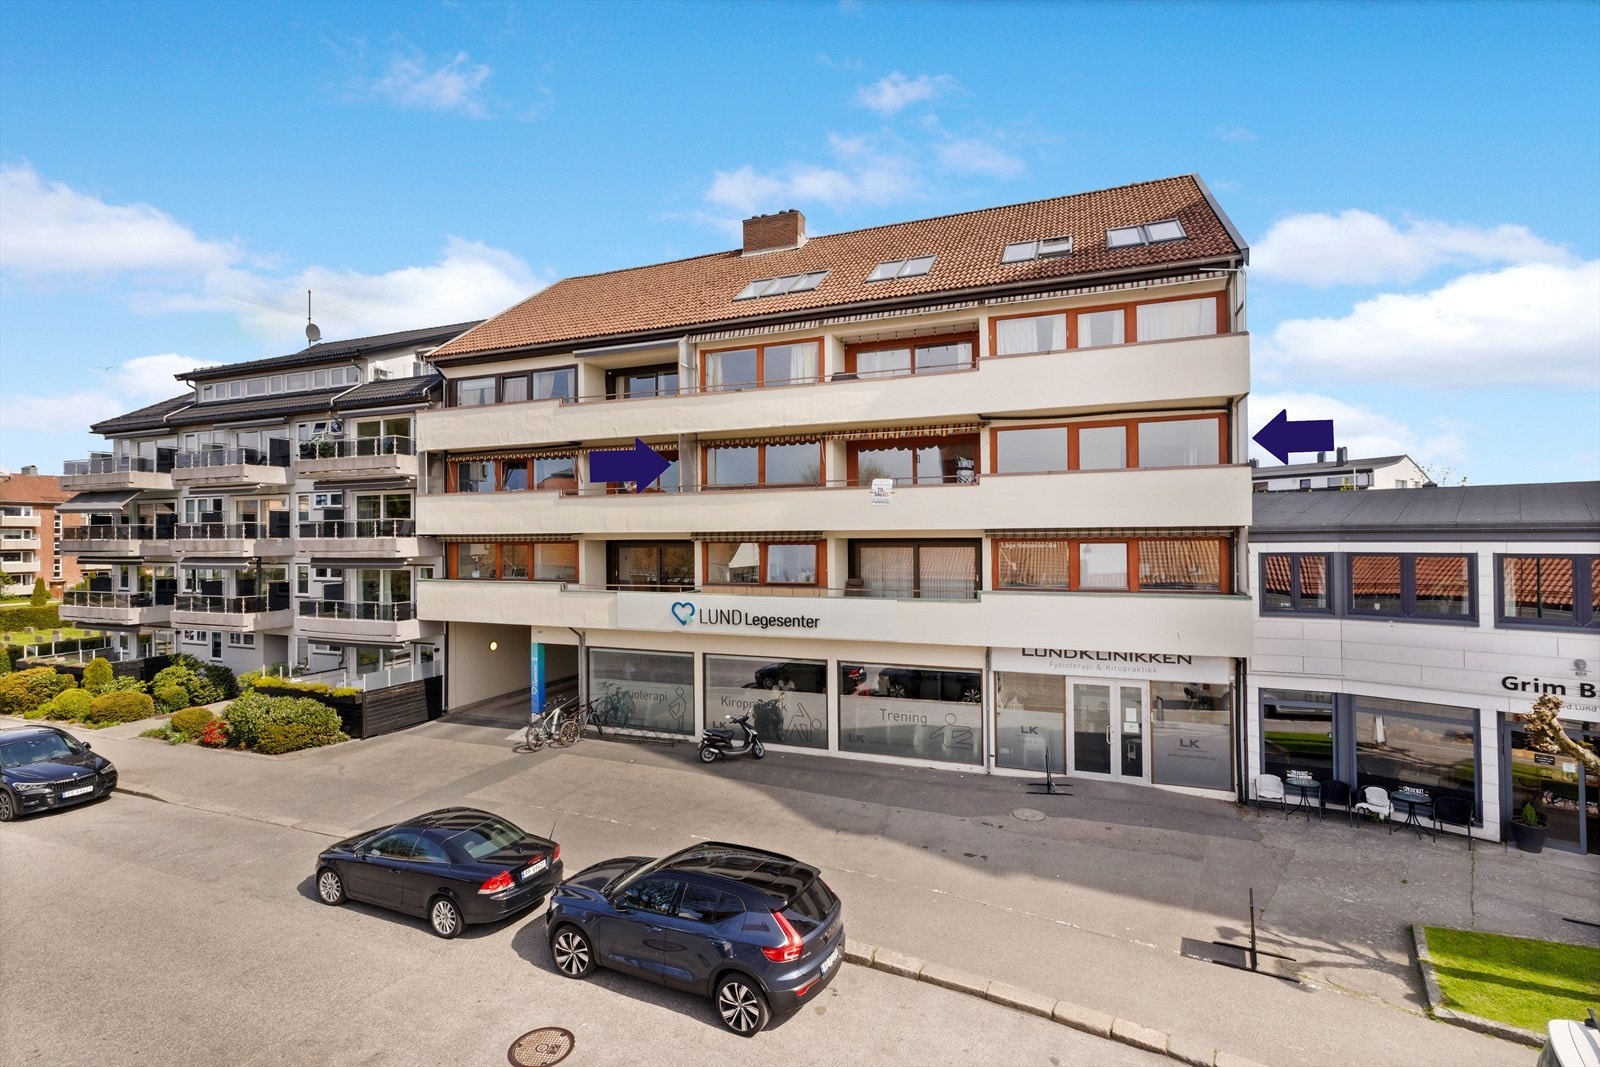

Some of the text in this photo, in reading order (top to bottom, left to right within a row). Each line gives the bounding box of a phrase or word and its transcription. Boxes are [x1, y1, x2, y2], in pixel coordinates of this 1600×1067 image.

[699, 608, 820, 630] LUND Legesenter
[1049, 661, 1094, 670] Fysioterapi
[1105, 664, 1158, 674] Kiropraktikk
[1501, 676, 1600, 698] Grim B
[1563, 704, 1597, 712] vd.Lund
[879, 708, 928, 727] Trening
[712, 721, 727, 730] LK
[1020, 726, 1039, 735] LK
[848, 734, 865, 743] LK
[1179, 738, 1200, 749] LK
